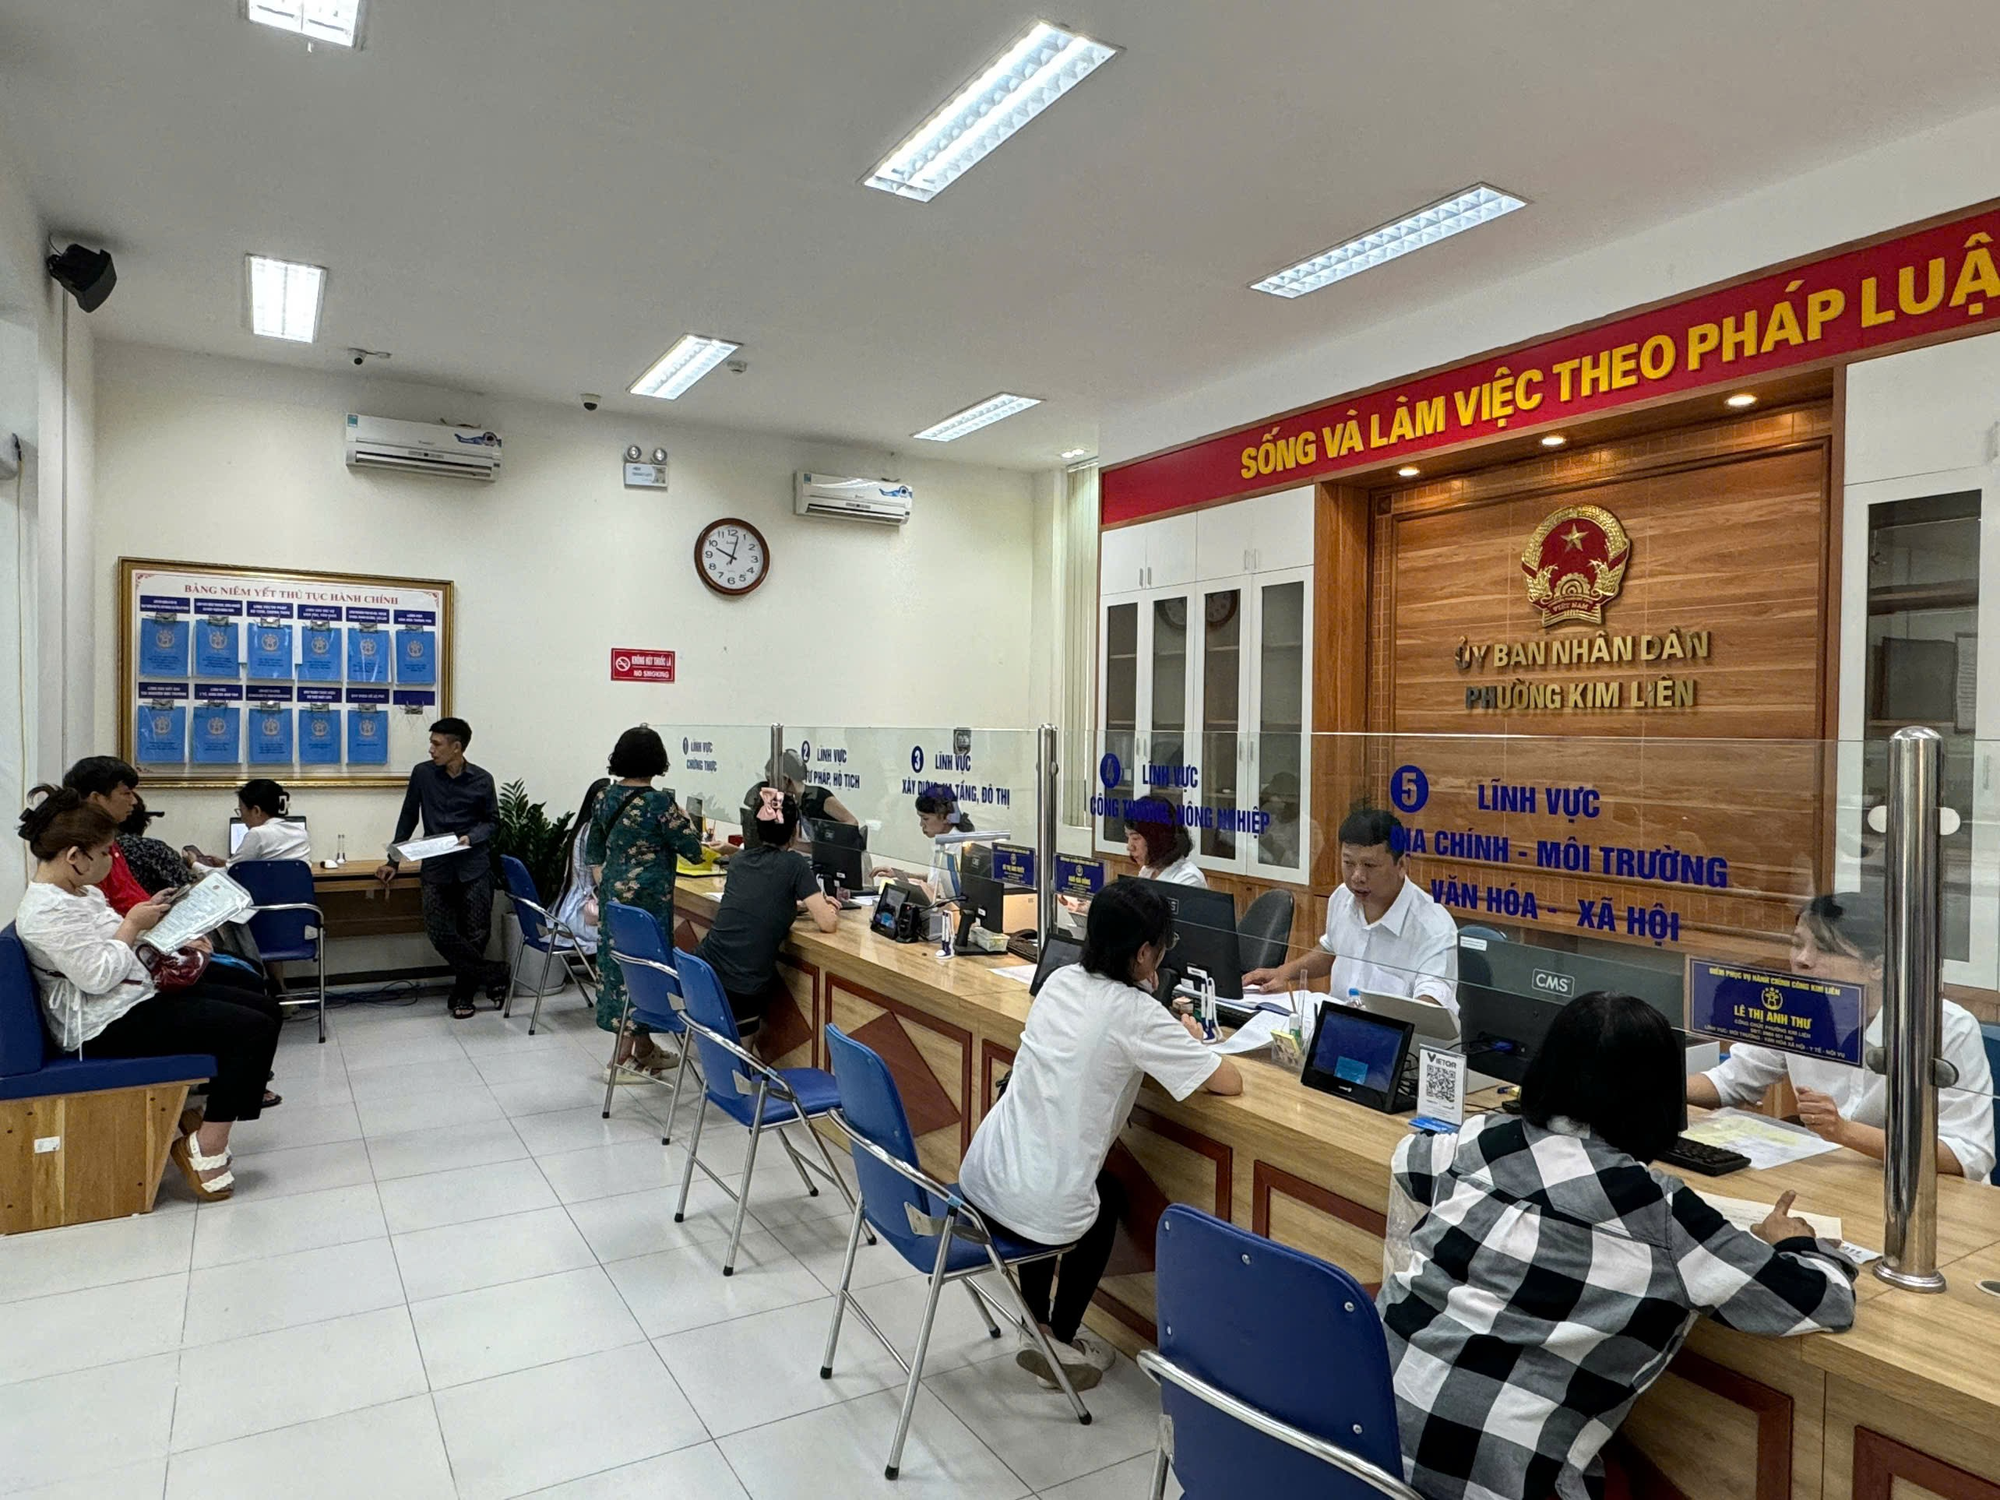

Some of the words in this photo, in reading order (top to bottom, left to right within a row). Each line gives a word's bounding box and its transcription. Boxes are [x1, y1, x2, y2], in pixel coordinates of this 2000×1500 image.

[1241, 426, 1316, 479] SỐNG
[1322, 409, 1364, 459] VÀ
[1370, 395, 1446, 449] LÀM
[1454, 366, 1544, 427] VIỆC
[1552, 334, 1677, 403] THEO
[1688, 279, 1847, 372] PHÁP
[708, 539, 718, 548] 10
[728, 529, 738, 537] 12
[705, 550, 714, 558] 9
[750, 556, 758, 564] 3
[708, 562, 716, 570] 8
[746, 566, 755, 574] 4
[727, 576, 736, 585] 6
[739, 574, 746, 582] 5
[184, 584, 218, 596] BẢNG
[220, 585, 251, 597] NIÊM
[254, 586, 276, 598] YẾT
[279, 589, 303, 600] THỦ
[305, 591, 328, 602] TỤC
[330, 591, 361, 603] HÀNH
[364, 592, 399, 604] CHÍNH
[1571, 602, 1589, 610] NAM
[1494, 640, 1546, 667] BAN
[1552, 630, 1632, 664] NHÂN
[1640, 626, 1710, 661] DÂN
[1465, 679, 1561, 710] PHƯỜNG
[1568, 681, 1620, 708] KIM
[1630, 675, 1694, 708] LIÊN
[935, 751, 953, 770] LĨNH
[955, 754, 972, 774] VỰC
[1142, 760, 1170, 787] LĨNH
[1174, 764, 1198, 793] VỰC
[902, 776, 916, 795] XÂY
[996, 788, 1010, 810] THỊ
[1478, 778, 1536, 814] LĨNH
[1546, 785, 1600, 824] VỰC
[1090, 792, 1119, 818] CÔNG
[1434, 828, 1509, 864] CHÍNH
[1536, 836, 1590, 873] MÔI
[1600, 844, 1728, 888] TRƯỜNG
[1431, 874, 1478, 911] VĂN
[1486, 882, 1538, 921] HÓA
[1577, 896, 1617, 932] XÃ
[1626, 902, 1680, 947] HỘI
[1535, 973, 1568, 992] CMS
[1734, 1004, 1746, 1016] LÊ
[1748, 1008, 1764, 1022] THỊ
[1766, 1011, 1788, 1024] ANH
[1790, 1014, 1812, 1030] THƯ
